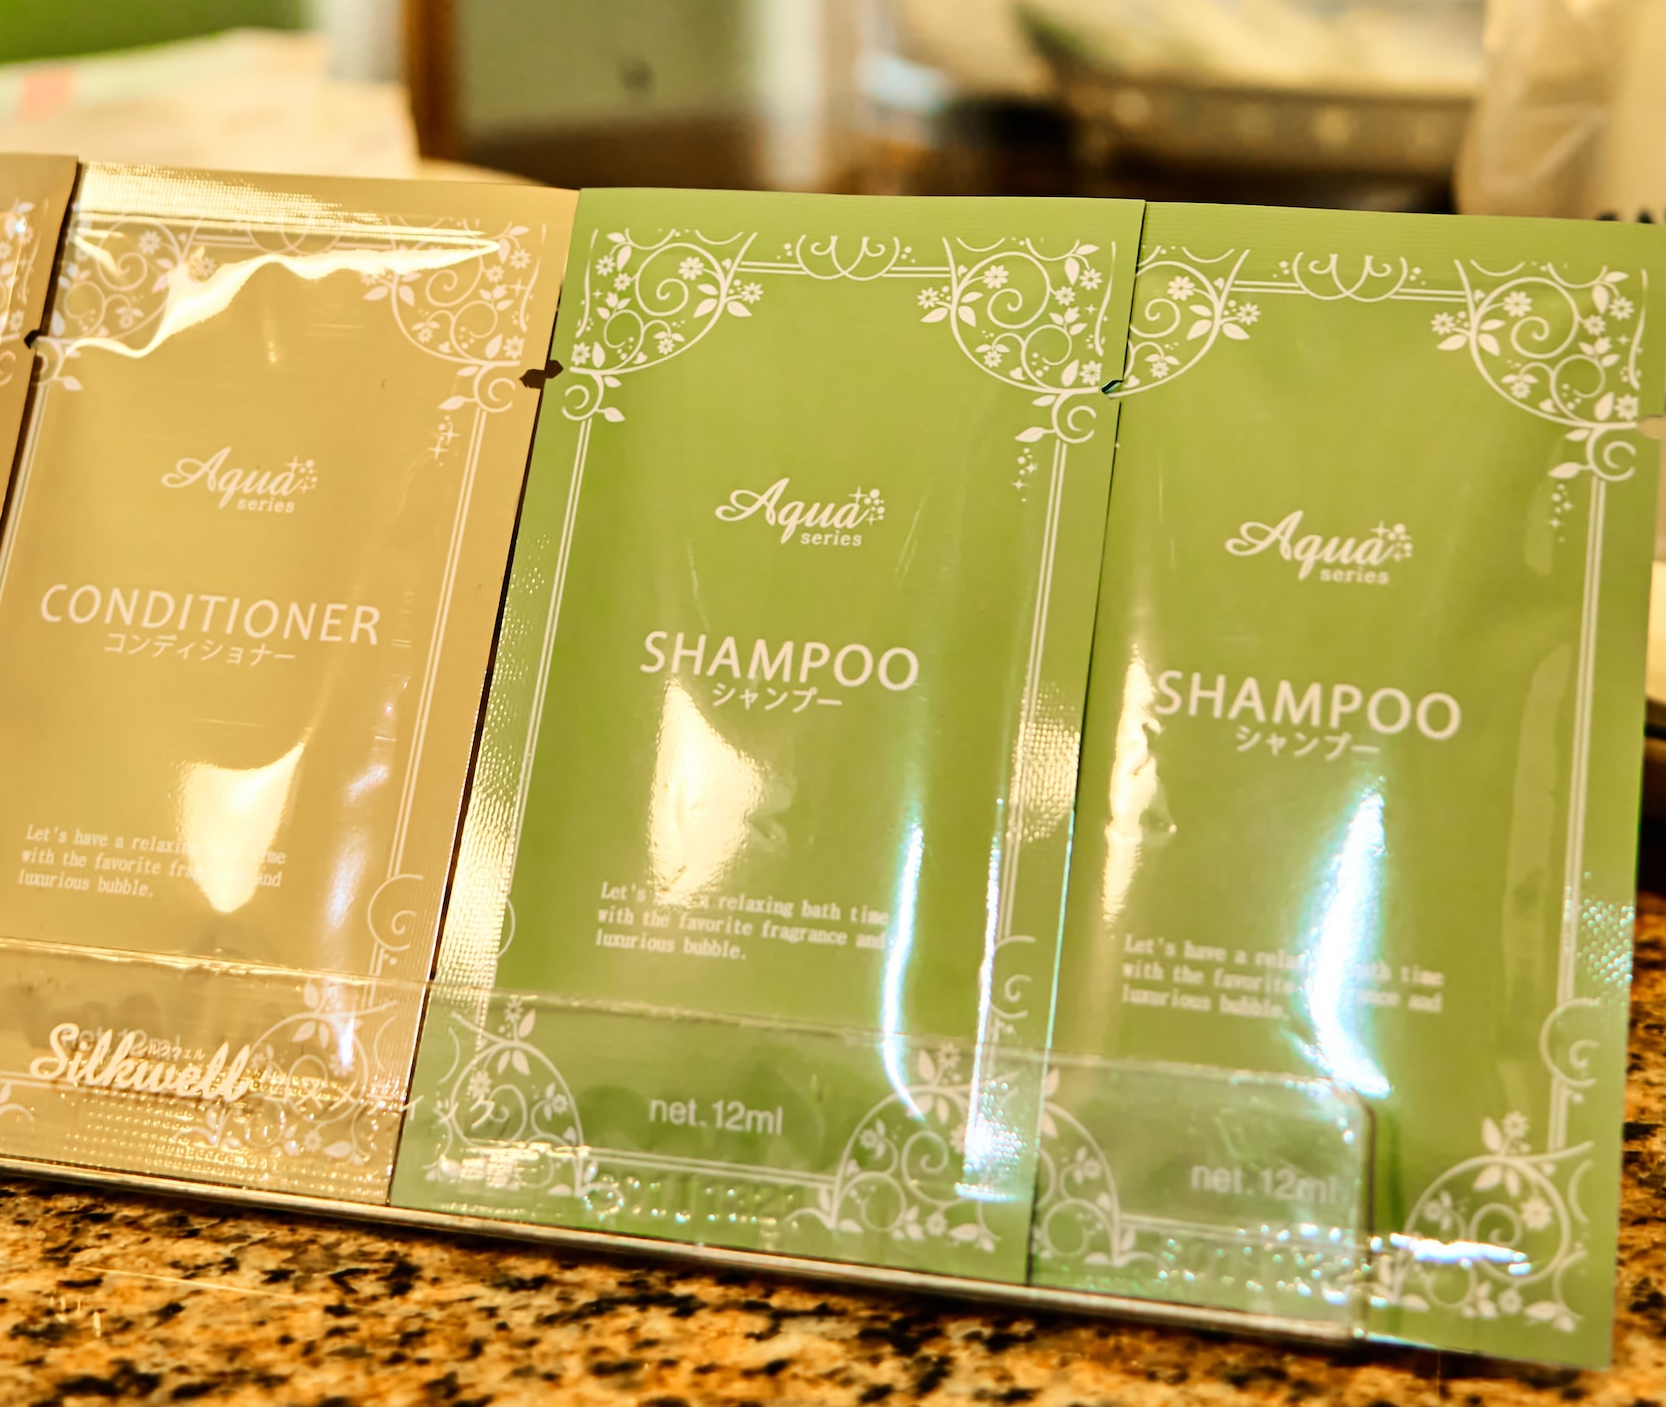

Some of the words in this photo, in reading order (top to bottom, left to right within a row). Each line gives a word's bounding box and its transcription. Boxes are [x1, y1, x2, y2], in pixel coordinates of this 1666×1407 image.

[161, 446, 303, 509] Aqua
[237, 495, 295, 513] series
[715, 477, 870, 544] Aqua
[800, 530, 862, 547] series
[1224, 510, 1395, 581] Aqua
[1320, 565, 1389, 585] series
[40, 583, 381, 645] CONDITIONER
[104, 633, 296, 667] コンディショナー
[639, 630, 920, 691] SHAMPOO
[712, 682, 843, 713] シャンプー
[1154, 669, 1463, 741] SHAMPOO
[1235, 725, 1381, 762] シャンプー
[26, 823, 67, 843] Let's
[74, 828, 108, 847] have
[115, 835, 124, 849] a
[131, 835, 200, 858] relaxin
[22, 848, 54, 865] with
[62, 850, 87, 868] the
[95, 852, 162, 875] favorite
[18, 869, 90, 890] luxurious
[97, 875, 153, 898] bubble.
[601, 881, 645, 901] Let's
[718, 893, 794, 918] relaxing
[801, 899, 841, 921] bath
[850, 905, 889, 926] time
[598, 905, 634, 925] with
[642, 909, 670, 929] the
[679, 911, 754, 937] favorite
[761, 920, 848, 946] fragrance
[595, 928, 675, 952] luxurious
[683, 937, 747, 961] bubble.
[1183, 940, 1227, 962] have
[30, 1022, 252, 1102] Silkwell
